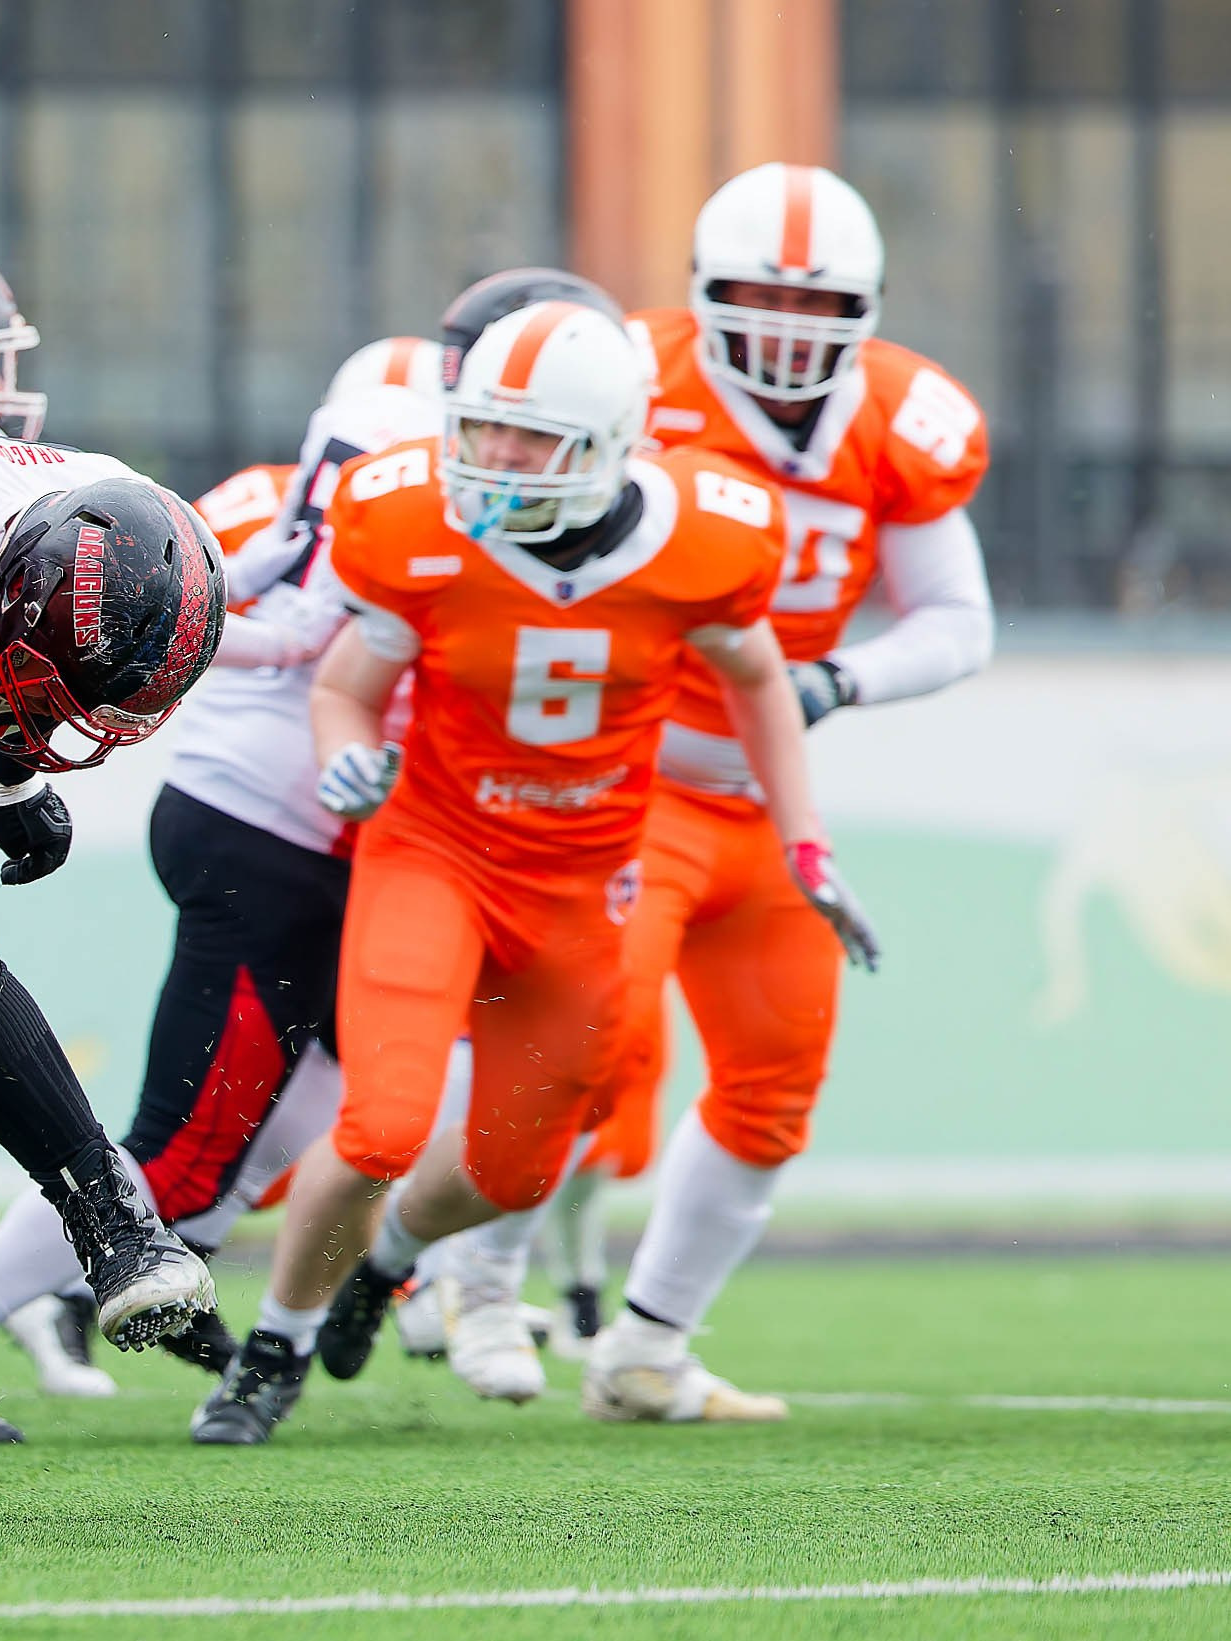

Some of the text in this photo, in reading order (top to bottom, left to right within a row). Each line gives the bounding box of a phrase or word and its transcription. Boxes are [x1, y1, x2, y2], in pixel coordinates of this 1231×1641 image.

[350, 448, 429, 501] 6
[694, 470, 771, 528] 6
[73, 526, 106, 647] DRAGONS
[505, 625, 612, 746] 6
